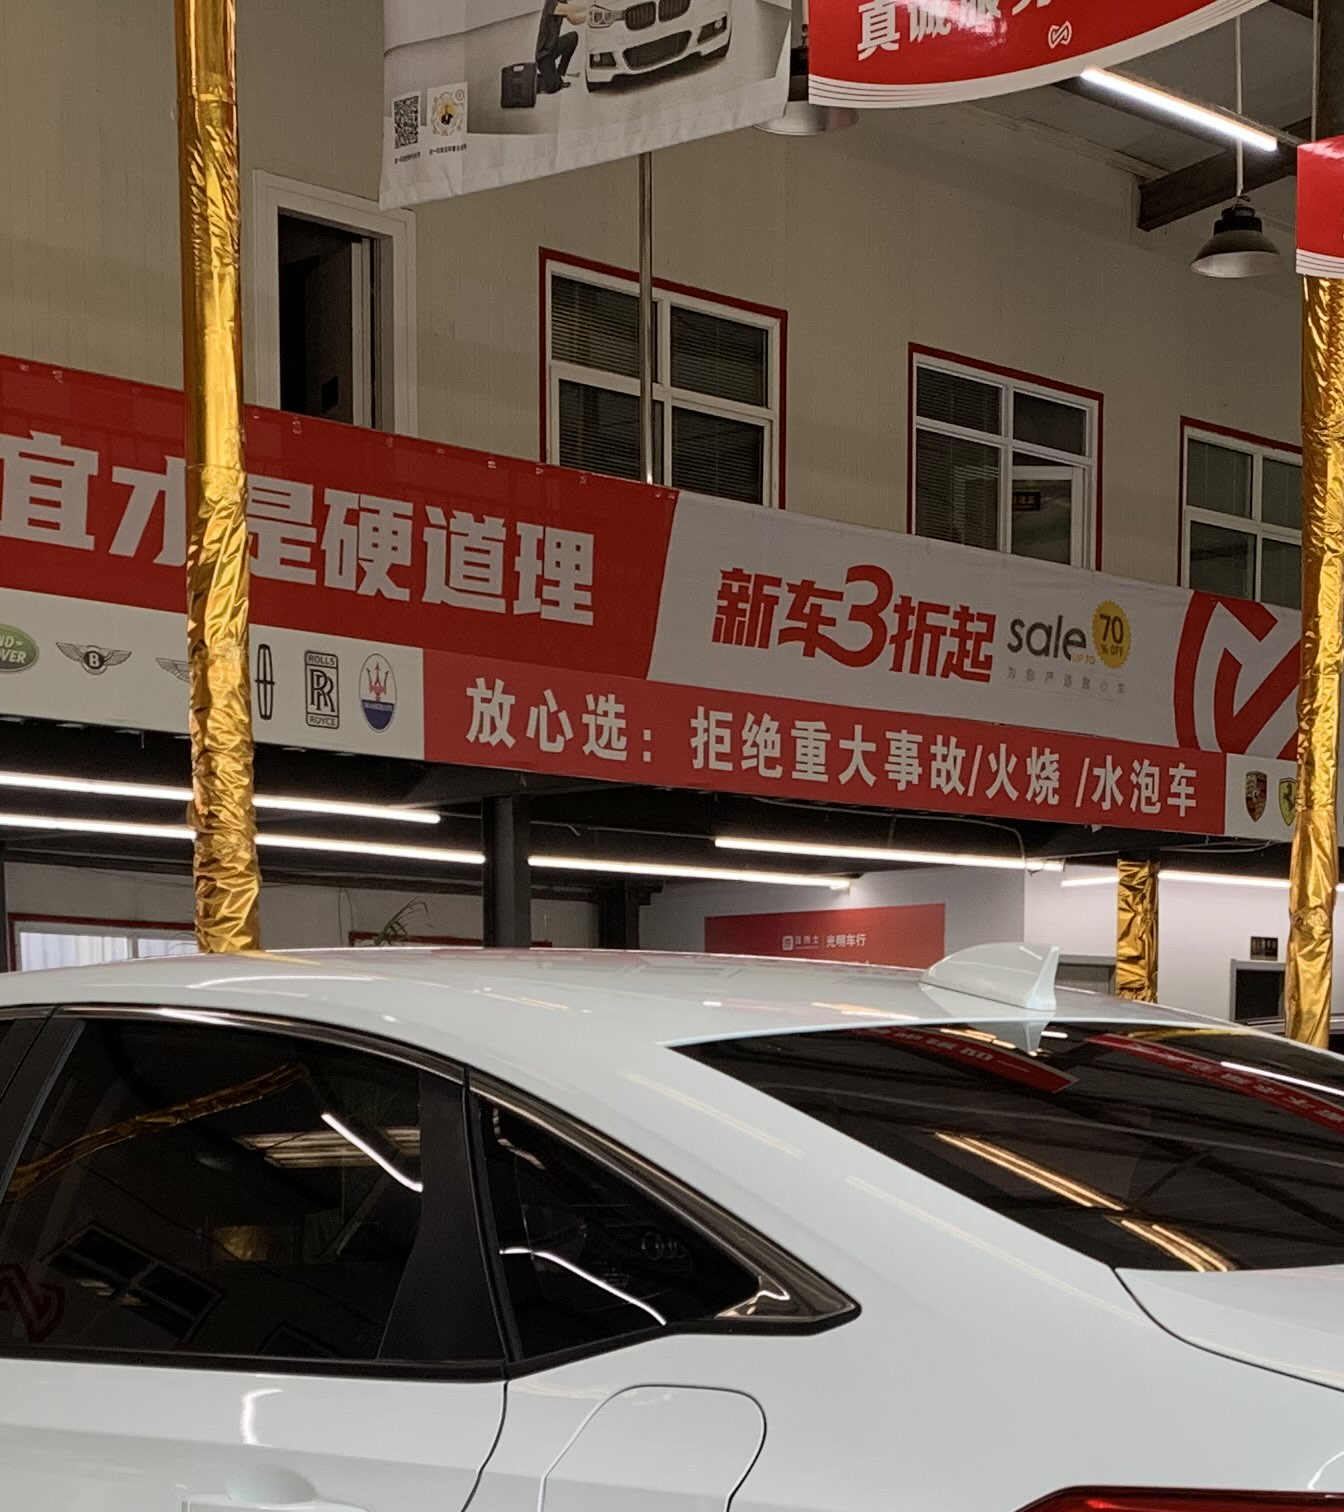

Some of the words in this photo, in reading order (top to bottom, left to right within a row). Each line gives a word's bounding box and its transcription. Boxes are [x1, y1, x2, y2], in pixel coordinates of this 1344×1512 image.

[711, 564, 997, 683] 新车3折起
[1007, 614, 1087, 661] sale
[1099, 613, 1124, 645] 70
[308, 654, 335, 666] ROLLS
[309, 715, 336, 727] ROYCE
